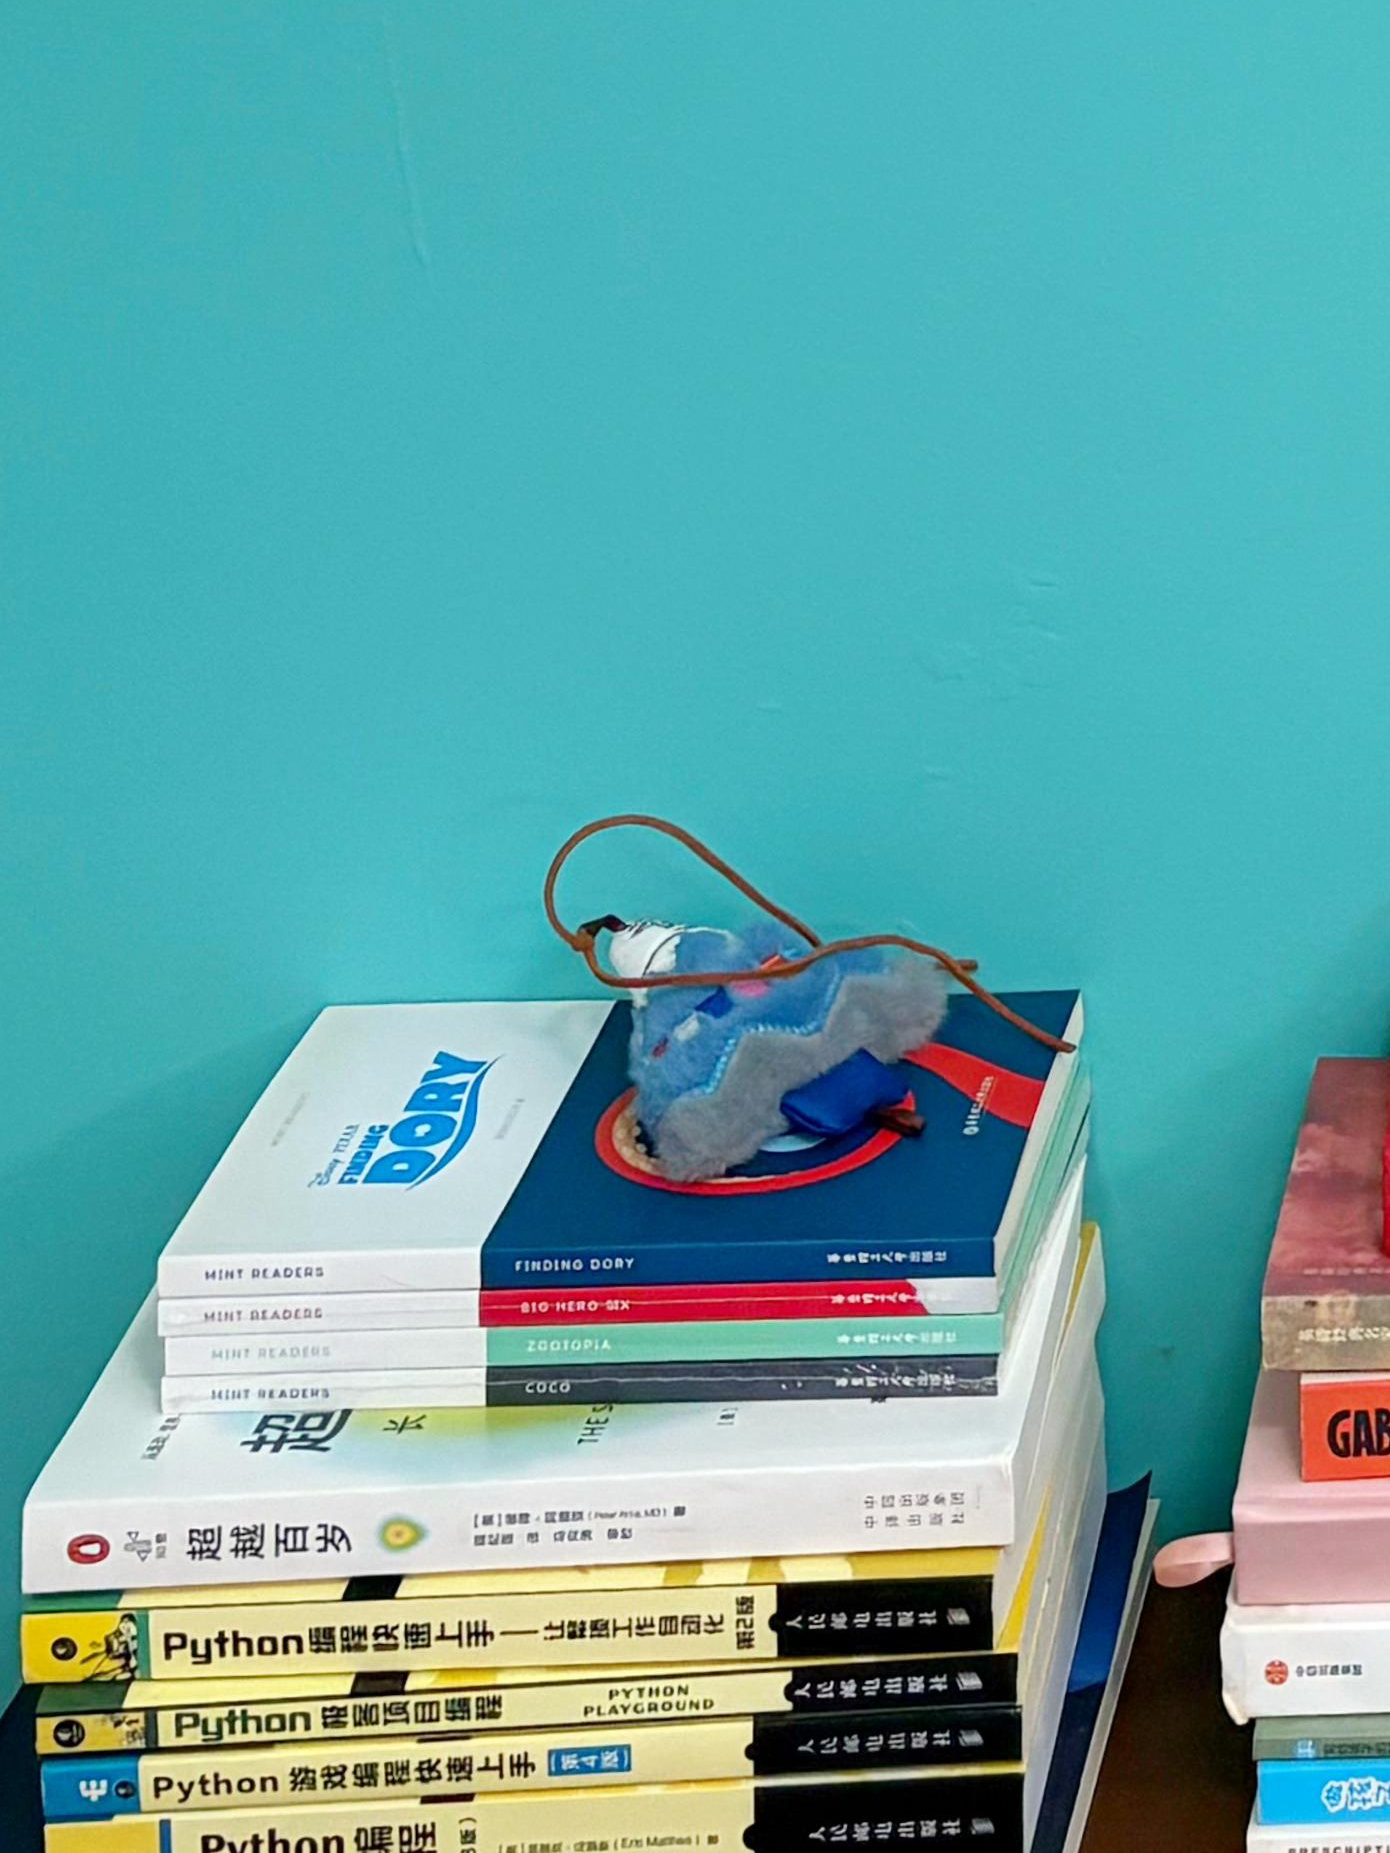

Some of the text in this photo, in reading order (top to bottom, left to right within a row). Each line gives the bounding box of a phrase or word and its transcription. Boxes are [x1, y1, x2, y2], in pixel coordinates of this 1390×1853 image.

[363, 1051, 489, 1185] DORY
[338, 1124, 389, 1185] FINDING
[205, 1266, 324, 1280] MINT READERS
[514, 1258, 635, 1272] FINDING DORY
[204, 1308, 323, 1322] MINT READERS
[520, 1299, 630, 1313] BIG HERO SIX
[211, 1346, 331, 1361] MINT READERS
[527, 1339, 611, 1352] ZOOTOPIA
[211, 1387, 330, 1401] MINT READERS
[525, 1381, 571, 1394] COCO
[577, 1416, 610, 1445] THE
[865, 1492, 964, 1509] 中国出版集团
[865, 1513, 964, 1528] 中译出版社
[187, 1524, 352, 1561] 超越百岁
[786, 1610, 937, 1630] 人民邮电出版社
[164, 1595, 755, 1665] Python 第2版
[608, 1684, 690, 1699] PYTHON
[795, 1673, 947, 1699] 人民邮电出版社
[583, 1698, 715, 1717] PLAYGROUND
[174, 1695, 503, 1742] Python 极客项目编程
[798, 1729, 950, 1754] 人民邮电出版社
[153, 1752, 536, 1802] Python 游戏编程快速上手
[809, 1820, 960, 1841] 人民邮电出版社
